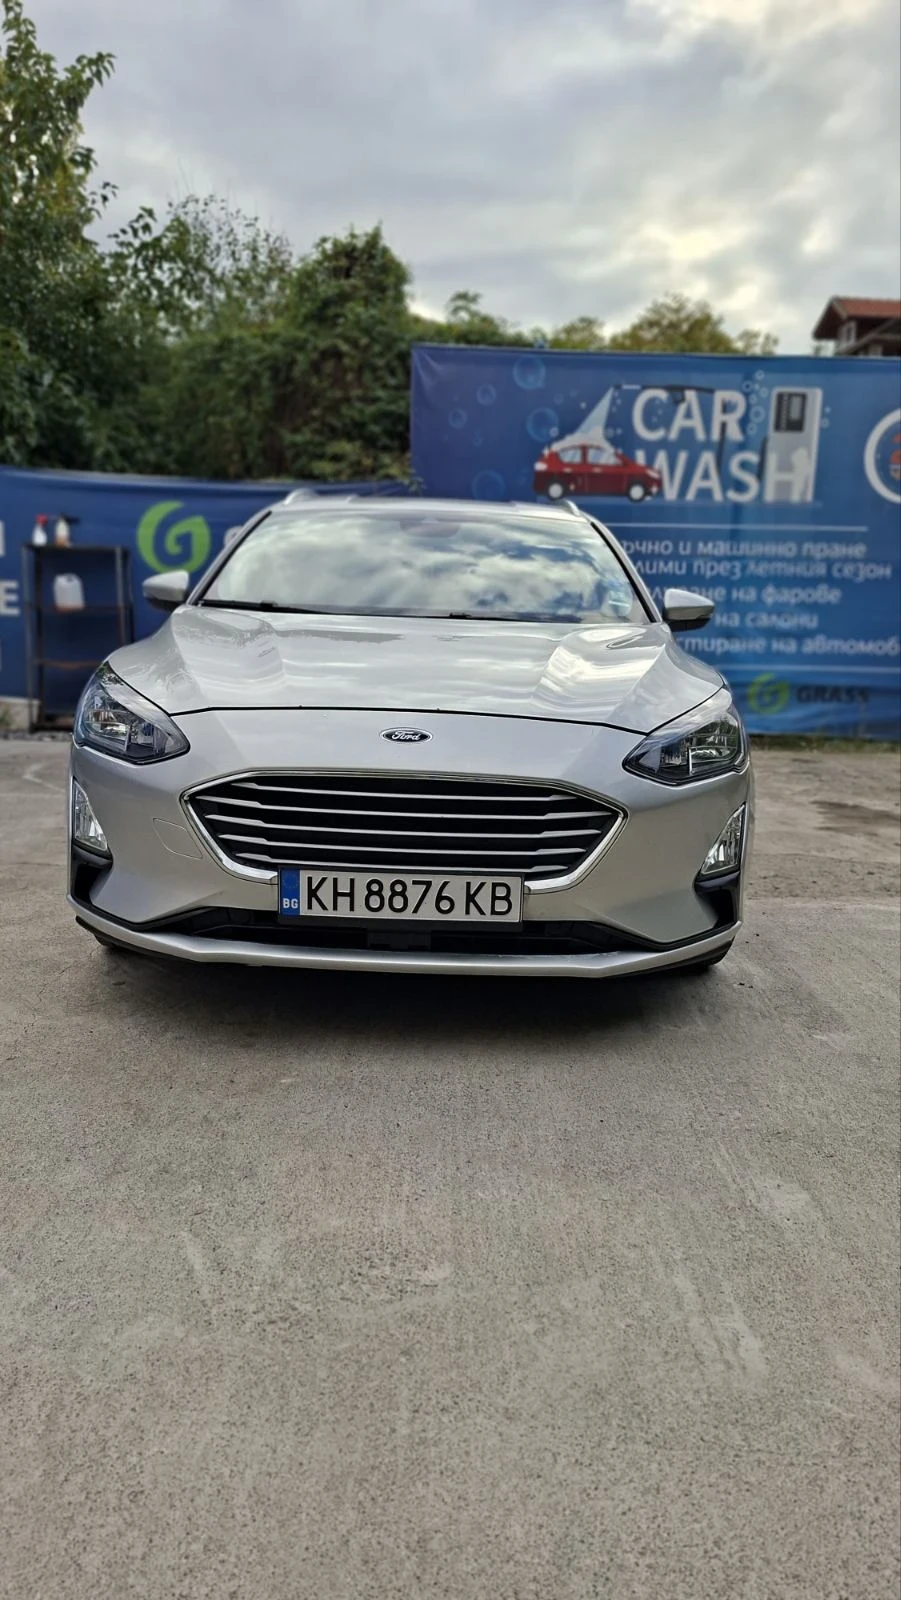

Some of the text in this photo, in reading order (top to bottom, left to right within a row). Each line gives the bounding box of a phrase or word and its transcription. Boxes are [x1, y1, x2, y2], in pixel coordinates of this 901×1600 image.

[632, 388, 747, 442] CAR
[634, 449, 815, 503] WASH
[679, 541, 692, 555] и
[698, 541, 797, 558] машинно
[802, 542, 867, 560] пране
[693, 560, 741, 580] през
[832, 563, 892, 583] сезон
[732, 587, 757, 602] на
[762, 584, 841, 607] фарове
[715, 612, 819, 630] на салони
[771, 639, 797, 653] на
[797, 686, 869, 704] GRASS
[391, 731, 421, 740] Ford
[282, 898, 298, 909] BG
[306, 876, 512, 916] KH 8876 KB
